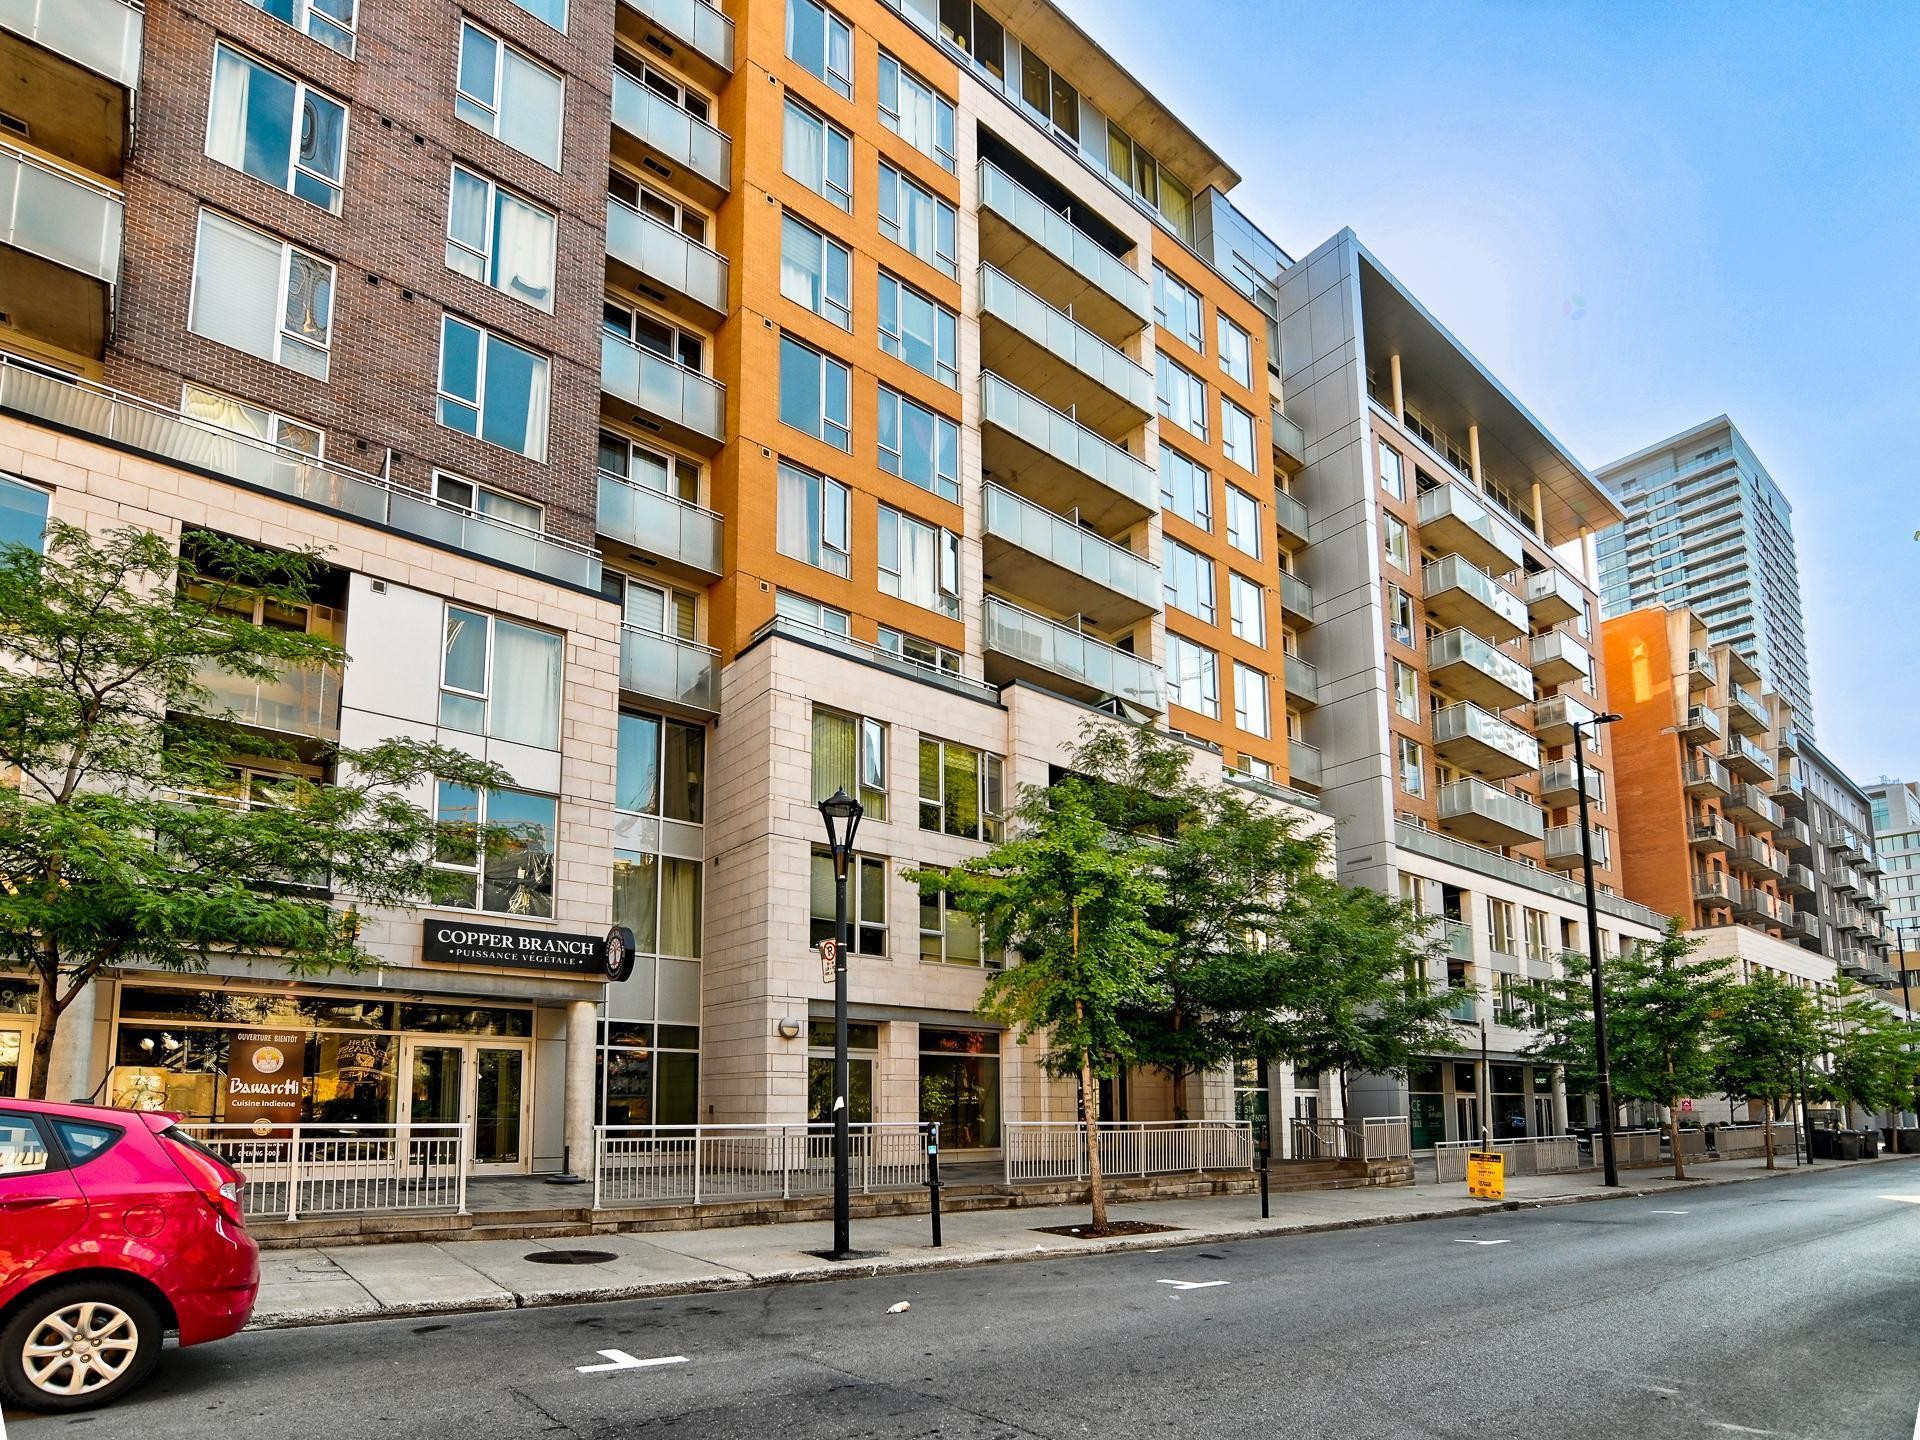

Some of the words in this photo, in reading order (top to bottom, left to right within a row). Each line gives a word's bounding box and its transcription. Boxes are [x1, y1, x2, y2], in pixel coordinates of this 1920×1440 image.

[437, 929, 514, 949] COPPER
[518, 937, 594, 956] BRANCH
[456, 949, 518, 961] PUISSANCE
[522, 951, 576, 965] VÉGÉTALE
[237, 1033, 272, 1042] OUVERTURE
[274, 1035, 298, 1043] BIENTÔT
[231, 1099, 261, 1108] Cuisine
[261, 1099, 296, 1108] Indienne
